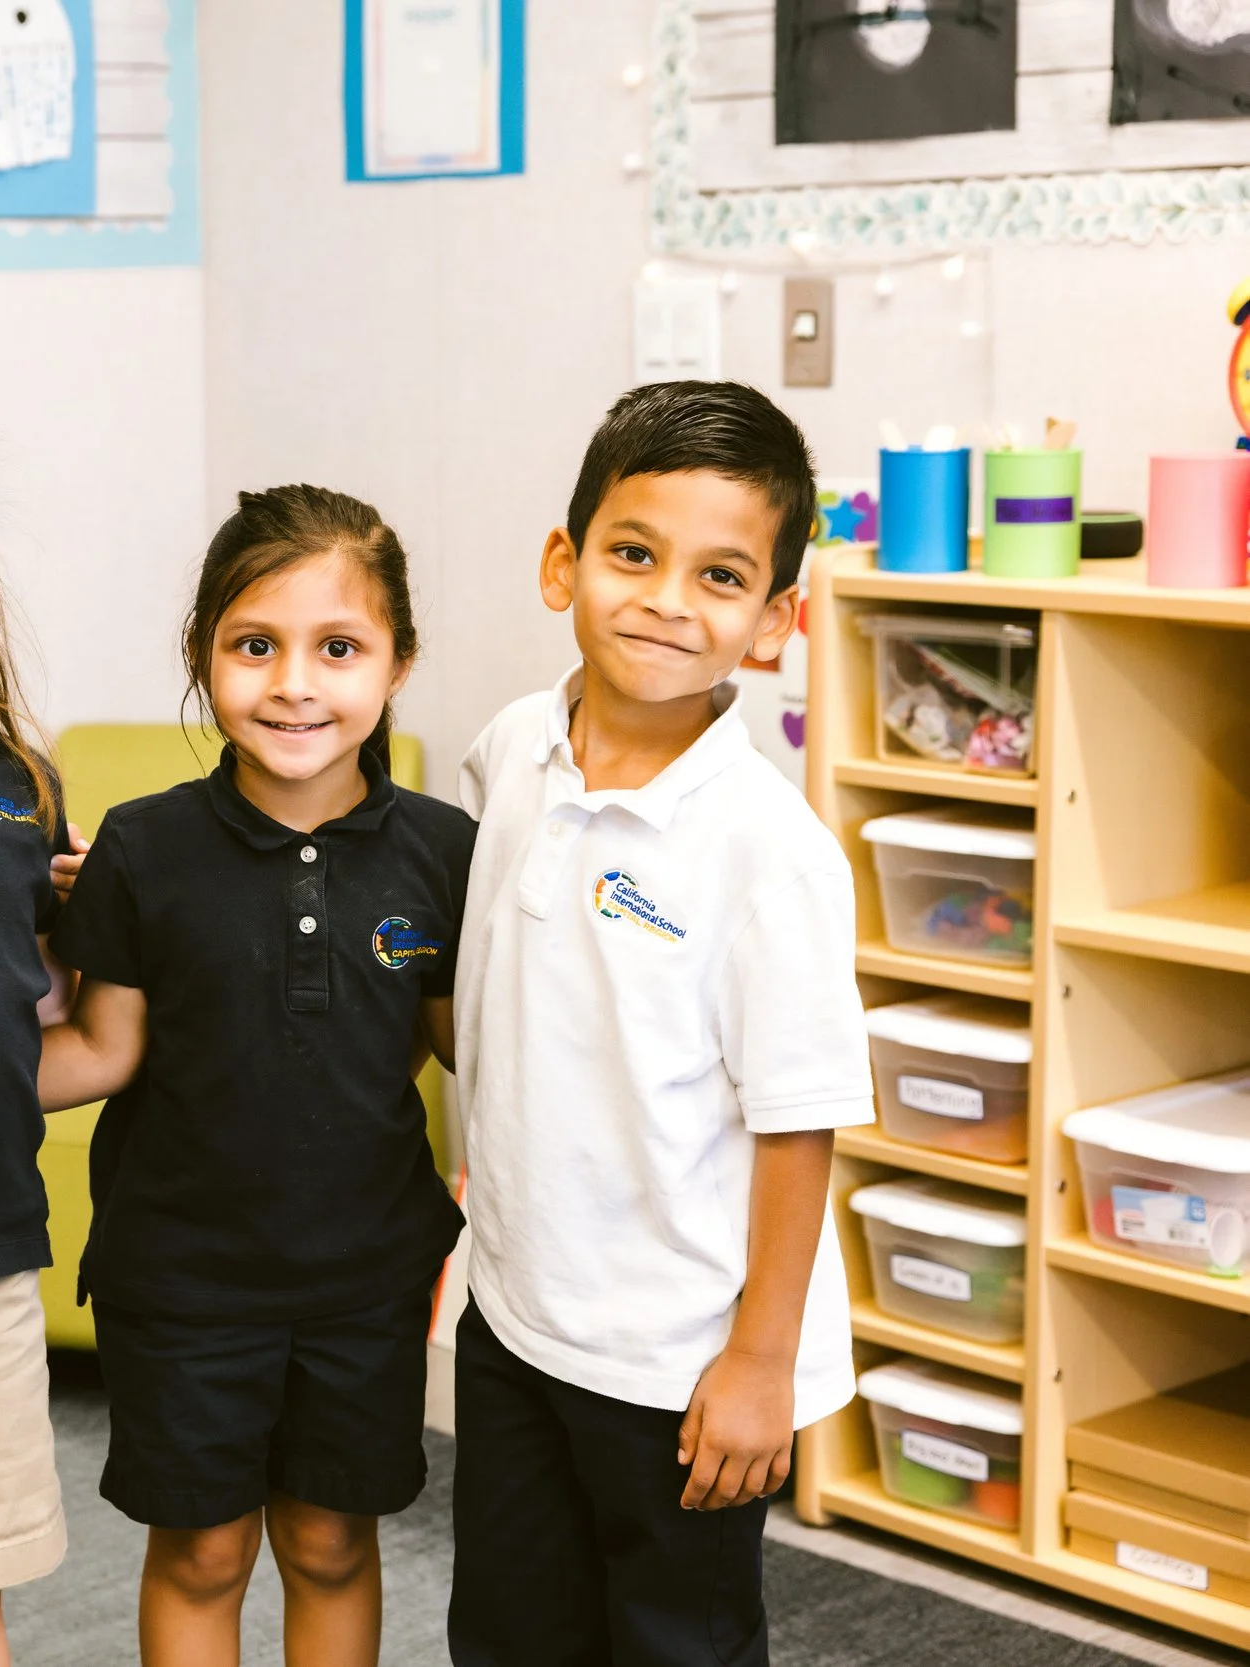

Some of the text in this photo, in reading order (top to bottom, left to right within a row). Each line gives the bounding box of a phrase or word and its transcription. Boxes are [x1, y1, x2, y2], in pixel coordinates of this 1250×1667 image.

[610, 890, 687, 939] International School
[615, 882, 656, 912] California
